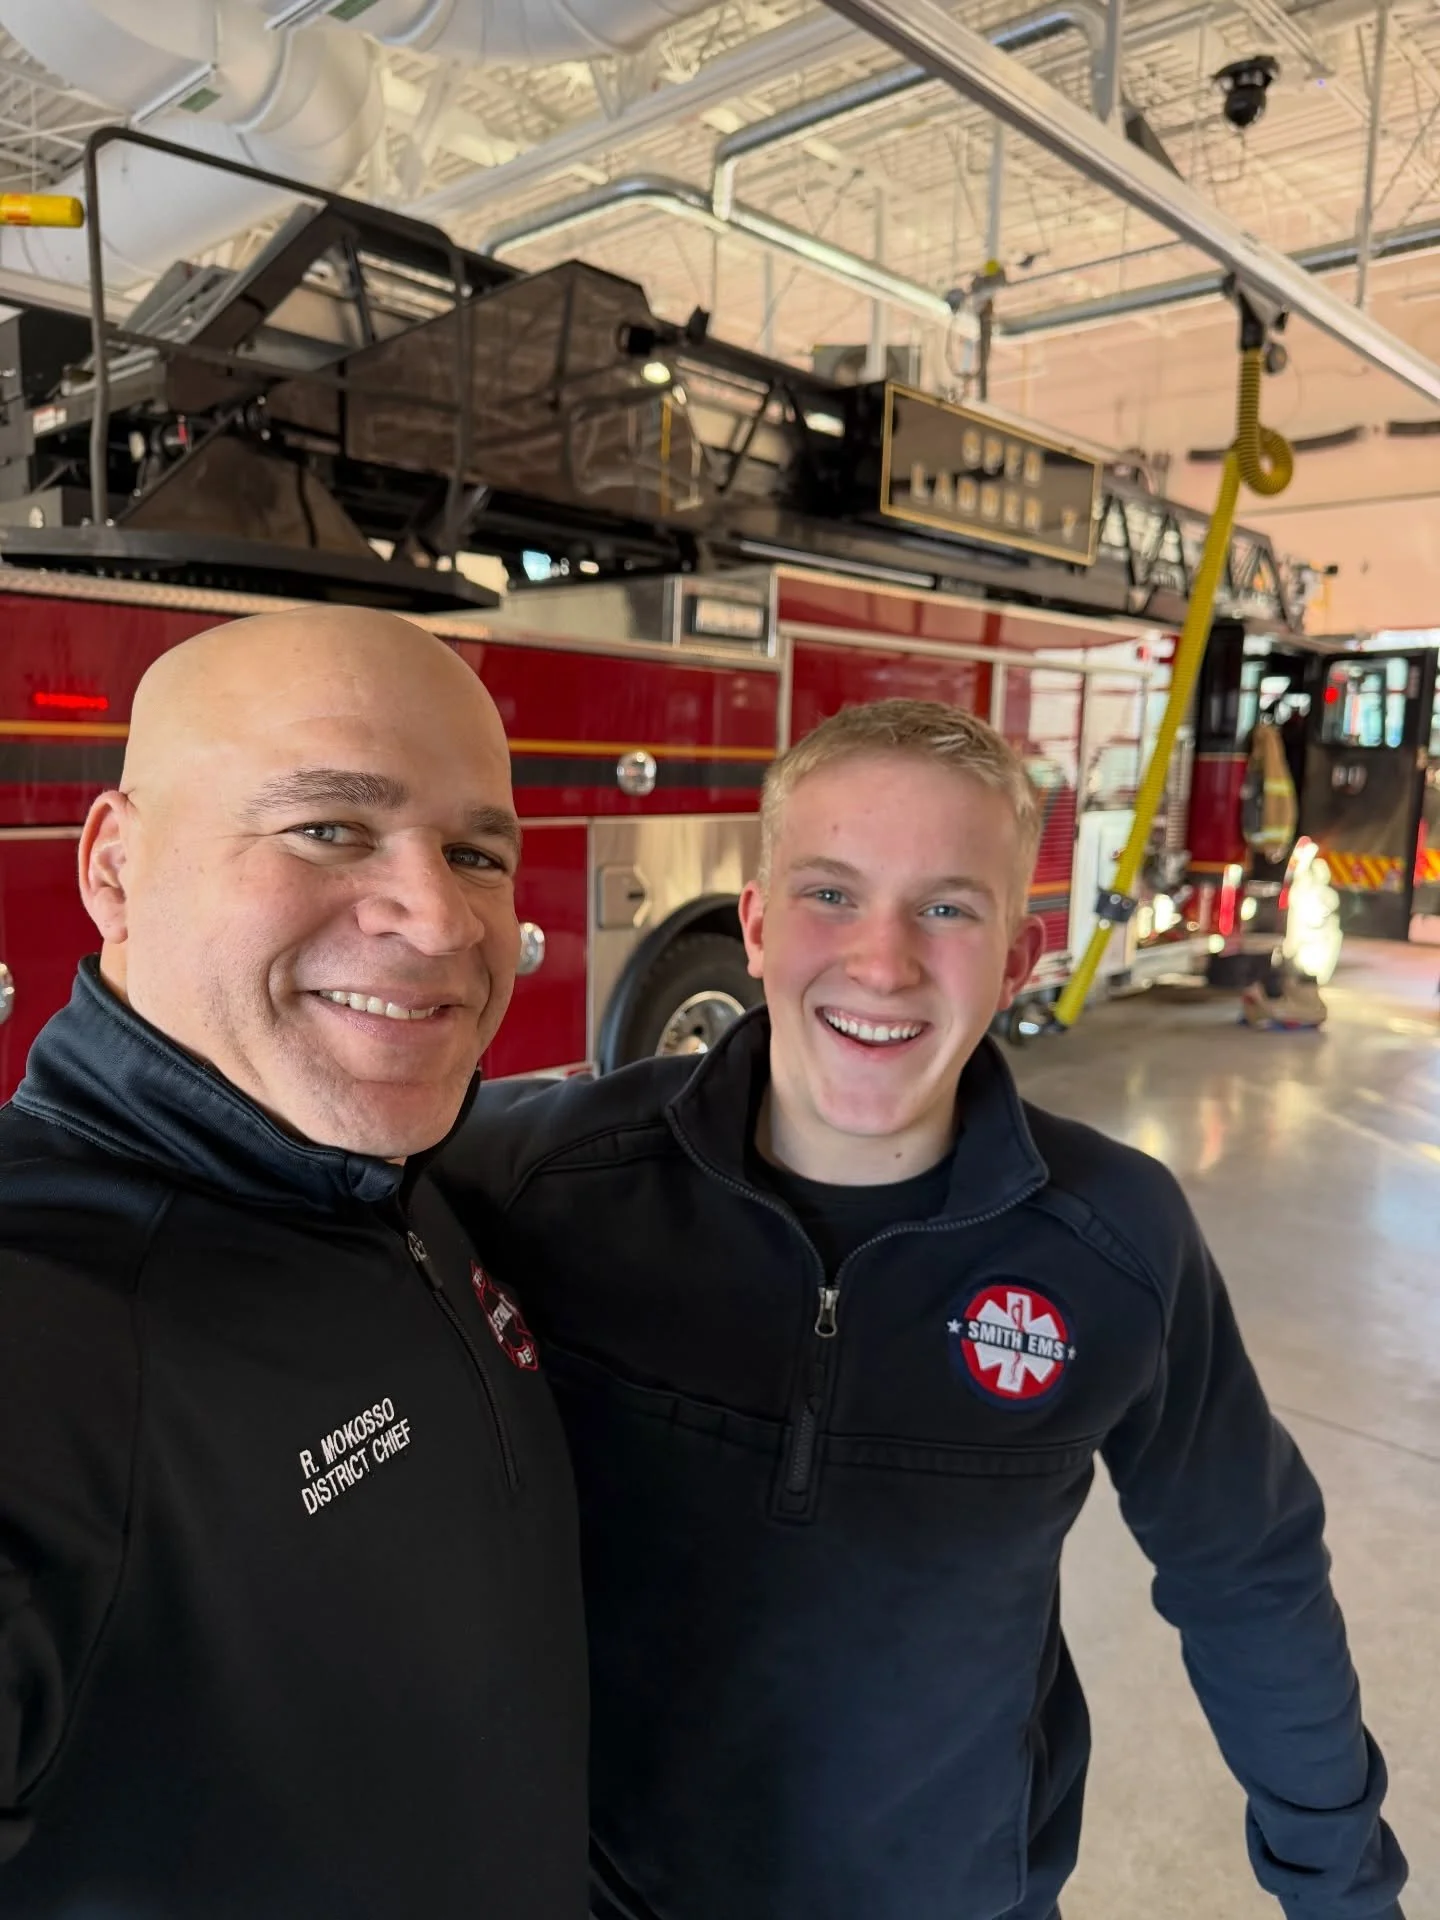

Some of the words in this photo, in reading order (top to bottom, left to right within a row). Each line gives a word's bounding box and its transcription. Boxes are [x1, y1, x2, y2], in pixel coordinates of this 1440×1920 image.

[910, 462, 1042, 536] LADDER
[967, 1321, 1023, 1352] SMITH
[1027, 1334, 1065, 1361] EMS
[299, 1449, 320, 1479] R.
[320, 1397, 395, 1465] MOKOSSO
[301, 1447, 370, 1516] DISTRICT
[372, 1418, 411, 1463] CHIEF
